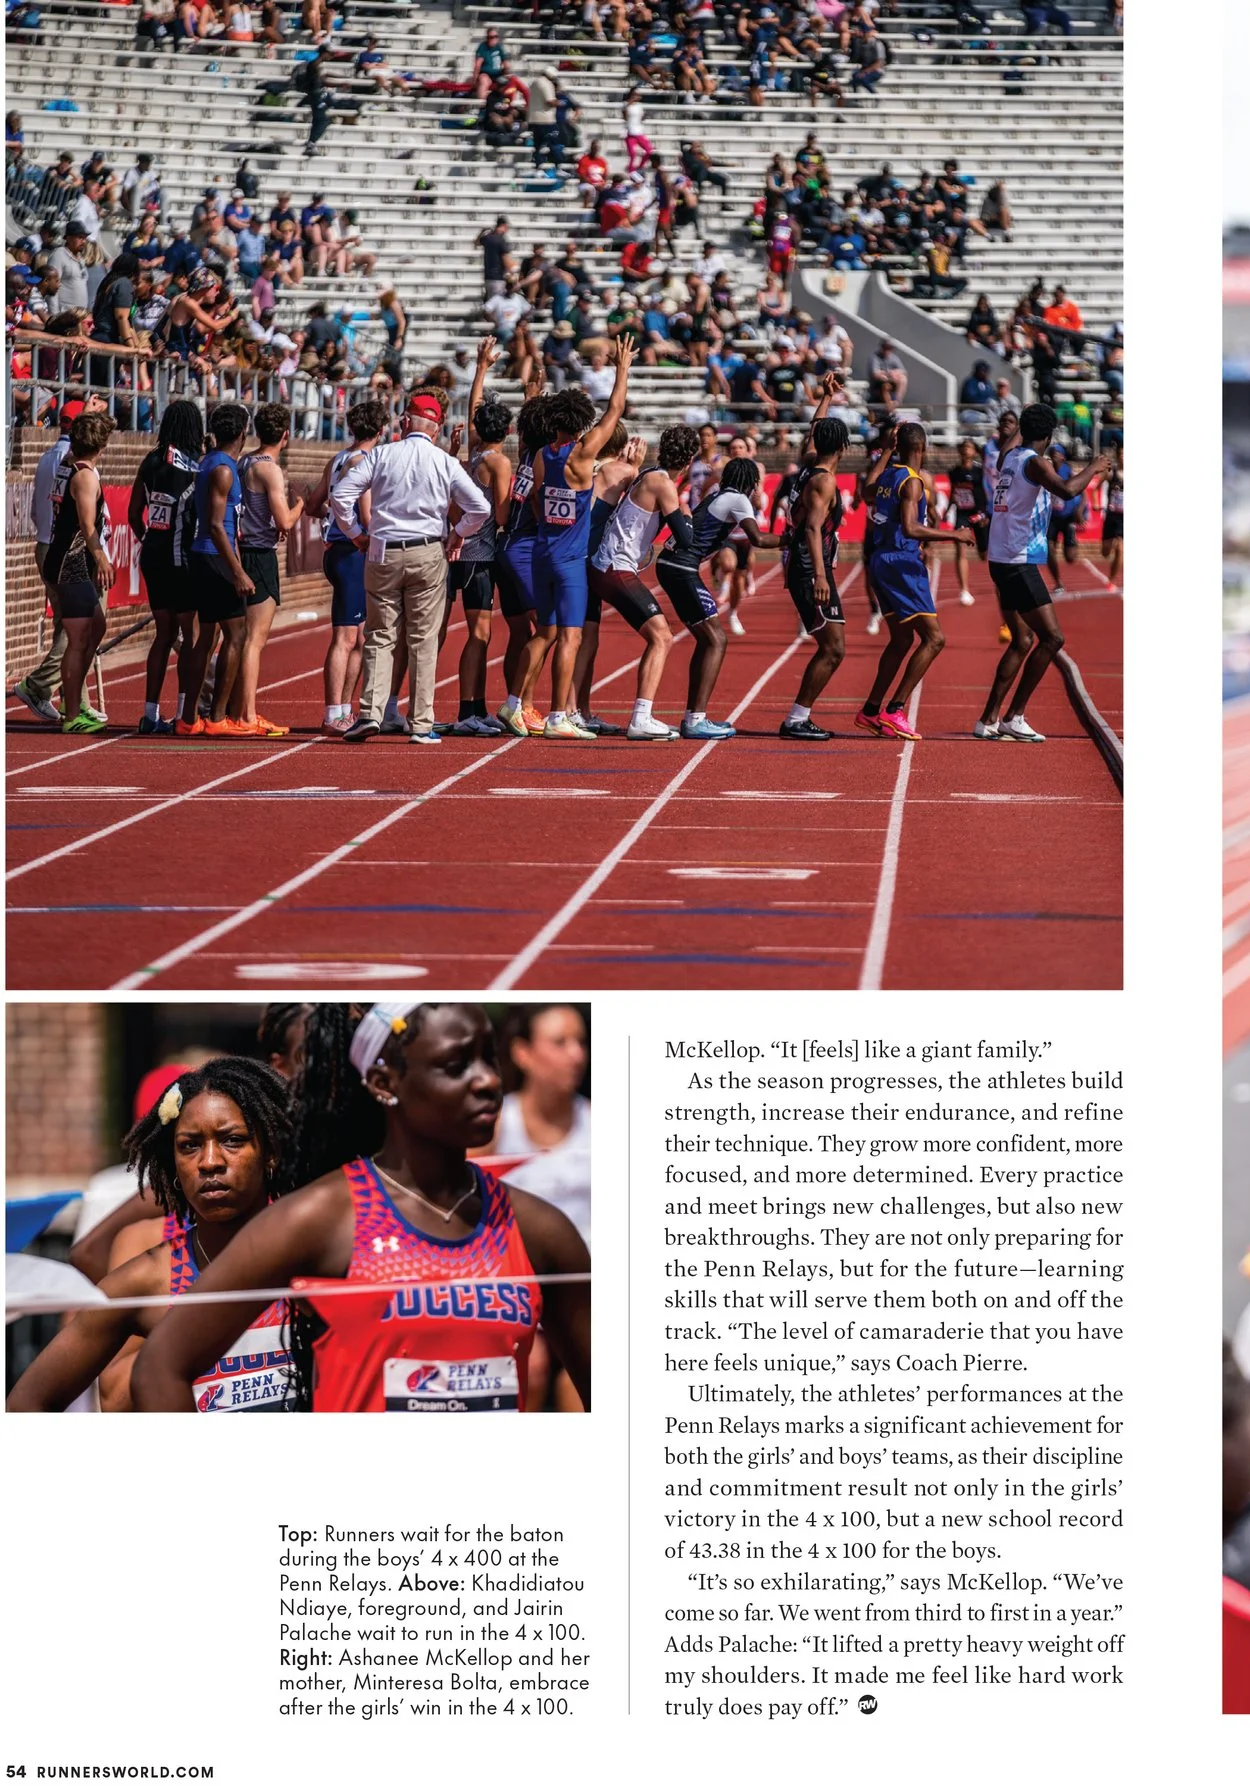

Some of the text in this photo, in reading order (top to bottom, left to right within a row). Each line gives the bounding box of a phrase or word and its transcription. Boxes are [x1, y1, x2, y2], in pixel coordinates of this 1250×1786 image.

[151, 505, 167, 522] ZA
[548, 501, 570, 518] ZO
[665, 1039, 1051, 1062] McKellop. “It [feels] like a giant family.”
[664, 1101, 1123, 1125] strength, increase their endurance, and refine
[664, 1164, 1123, 1187] focused, and more determined. Every practice
[664, 1226, 1123, 1250] breakthroughs. They are not only preparing for
[664, 1289, 1123, 1308] skills that will serve them both on and off the
[449, 1364, 488, 1378] PENN
[664, 1352, 1027, 1375] here feels unique,” says Coach Pierre.
[232, 1373, 274, 1393] PENN
[232, 1383, 288, 1405] RELAYS
[447, 1377, 502, 1391] RELAYS
[687, 1383, 1123, 1406] Ultimately, the athletes’ performances at the
[408, 1400, 446, 1411] Dream
[664, 1446, 1122, 1469] both the girls’ and boys’ teams, as their discipline
[278, 1523, 563, 1547] Top: Runners wait for the baton
[279, 1547, 558, 1571] during the boys’ 4 x 400 at the
[280, 1572, 583, 1596] Penn Relays. Above: Khadidiatou
[688, 1571, 1123, 1595] “It’s so exhilarating,” says McKellop. “We’ve
[280, 1597, 562, 1620] Ndiaye, foreground, and Jairin
[280, 1622, 584, 1640] Palache wait to run in the 4 x 100.
[663, 1633, 1125, 1657] Adds Palache: “It lifted a pretty heavy weight off
[280, 1647, 590, 1671] Right: Ashanee McKellop and her
[279, 1671, 589, 1693] mother, Minteresa Bolta, embrace
[279, 1696, 572, 1720] after the girls’ win in the 4 x 100.
[664, 1696, 713, 1719] truly
[718, 1696, 762, 1715] does
[768, 1703, 802, 1719] pay
[807, 1696, 848, 1715] off.”
[5, 1764, 213, 1778] 54 RUNNERSWORLD.COM
